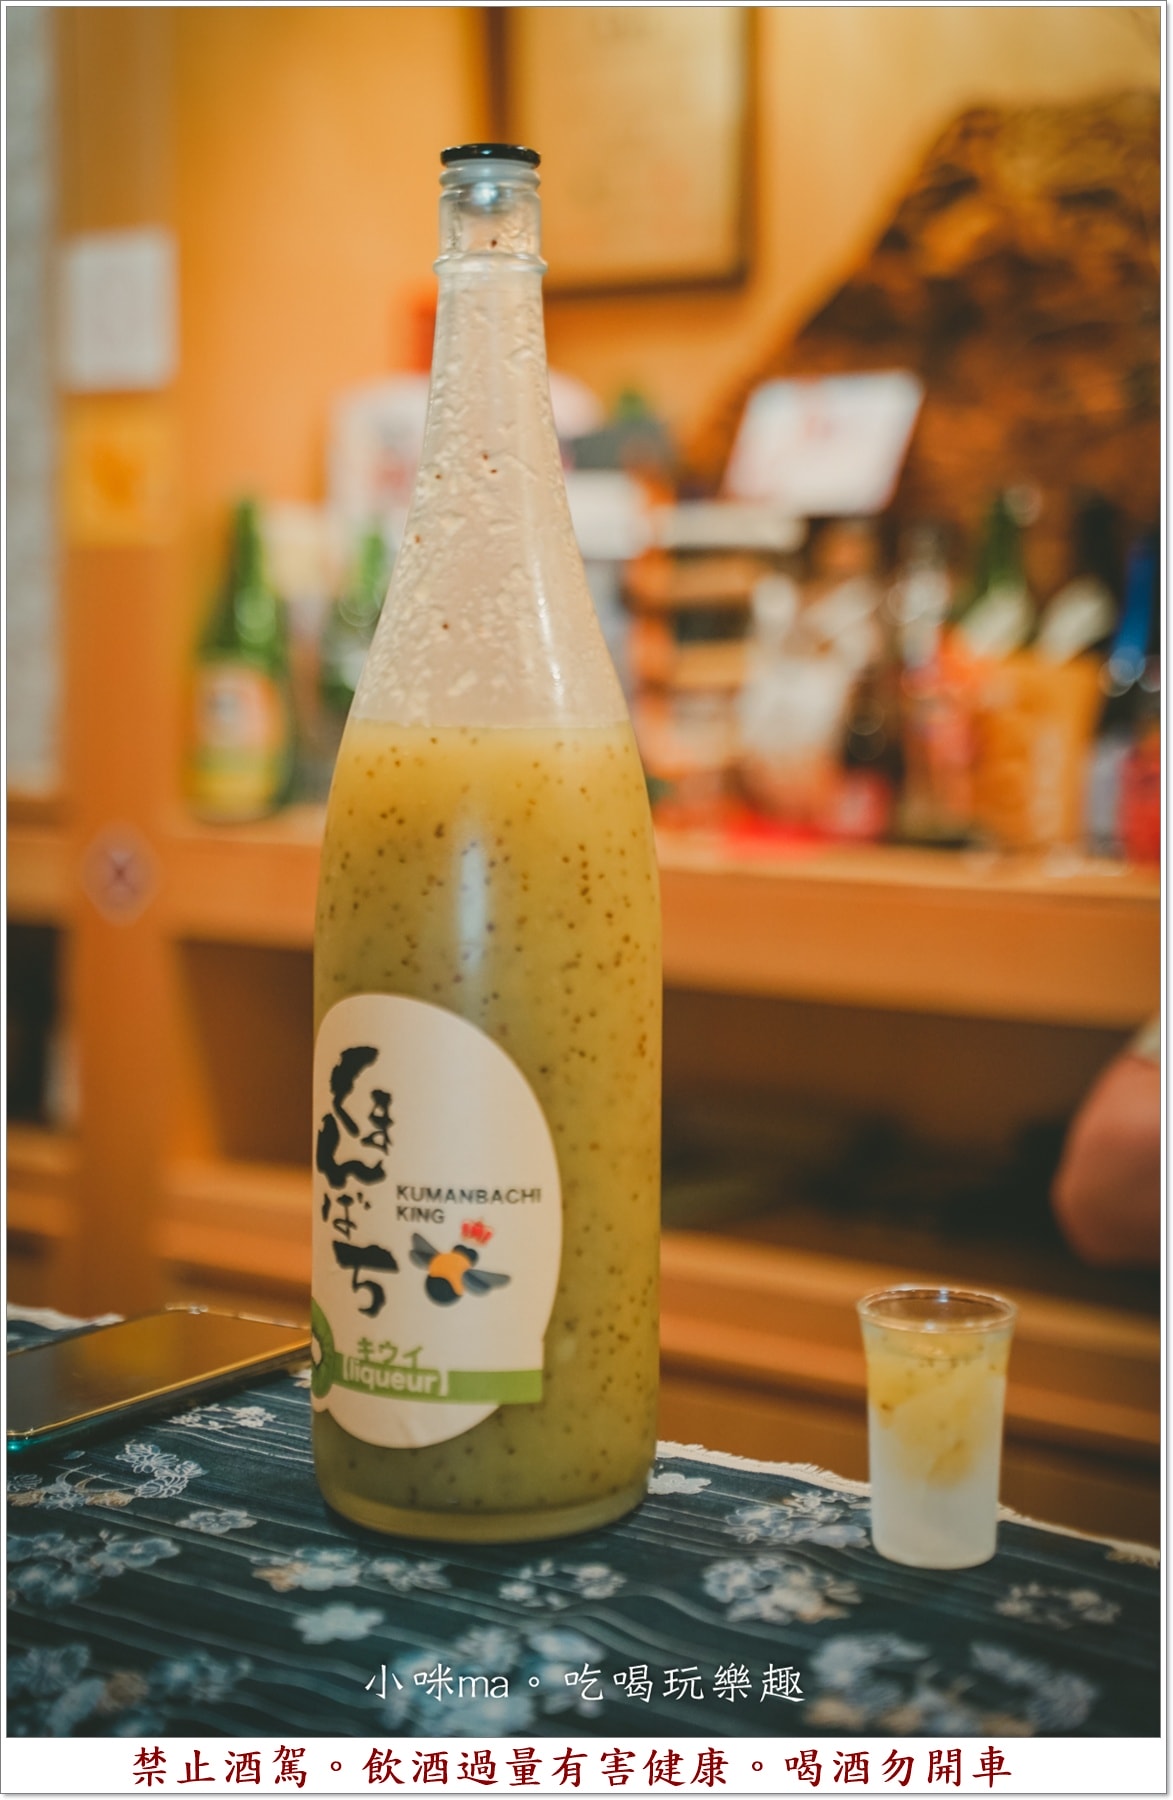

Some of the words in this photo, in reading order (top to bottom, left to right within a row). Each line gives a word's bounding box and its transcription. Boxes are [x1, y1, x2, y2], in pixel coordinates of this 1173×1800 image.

[316, 1046, 398, 1318] くまんばち
[396, 1185, 541, 1205] KUMANBACHI
[396, 1206, 445, 1224] KING
[357, 1337, 423, 1368] キウイ
